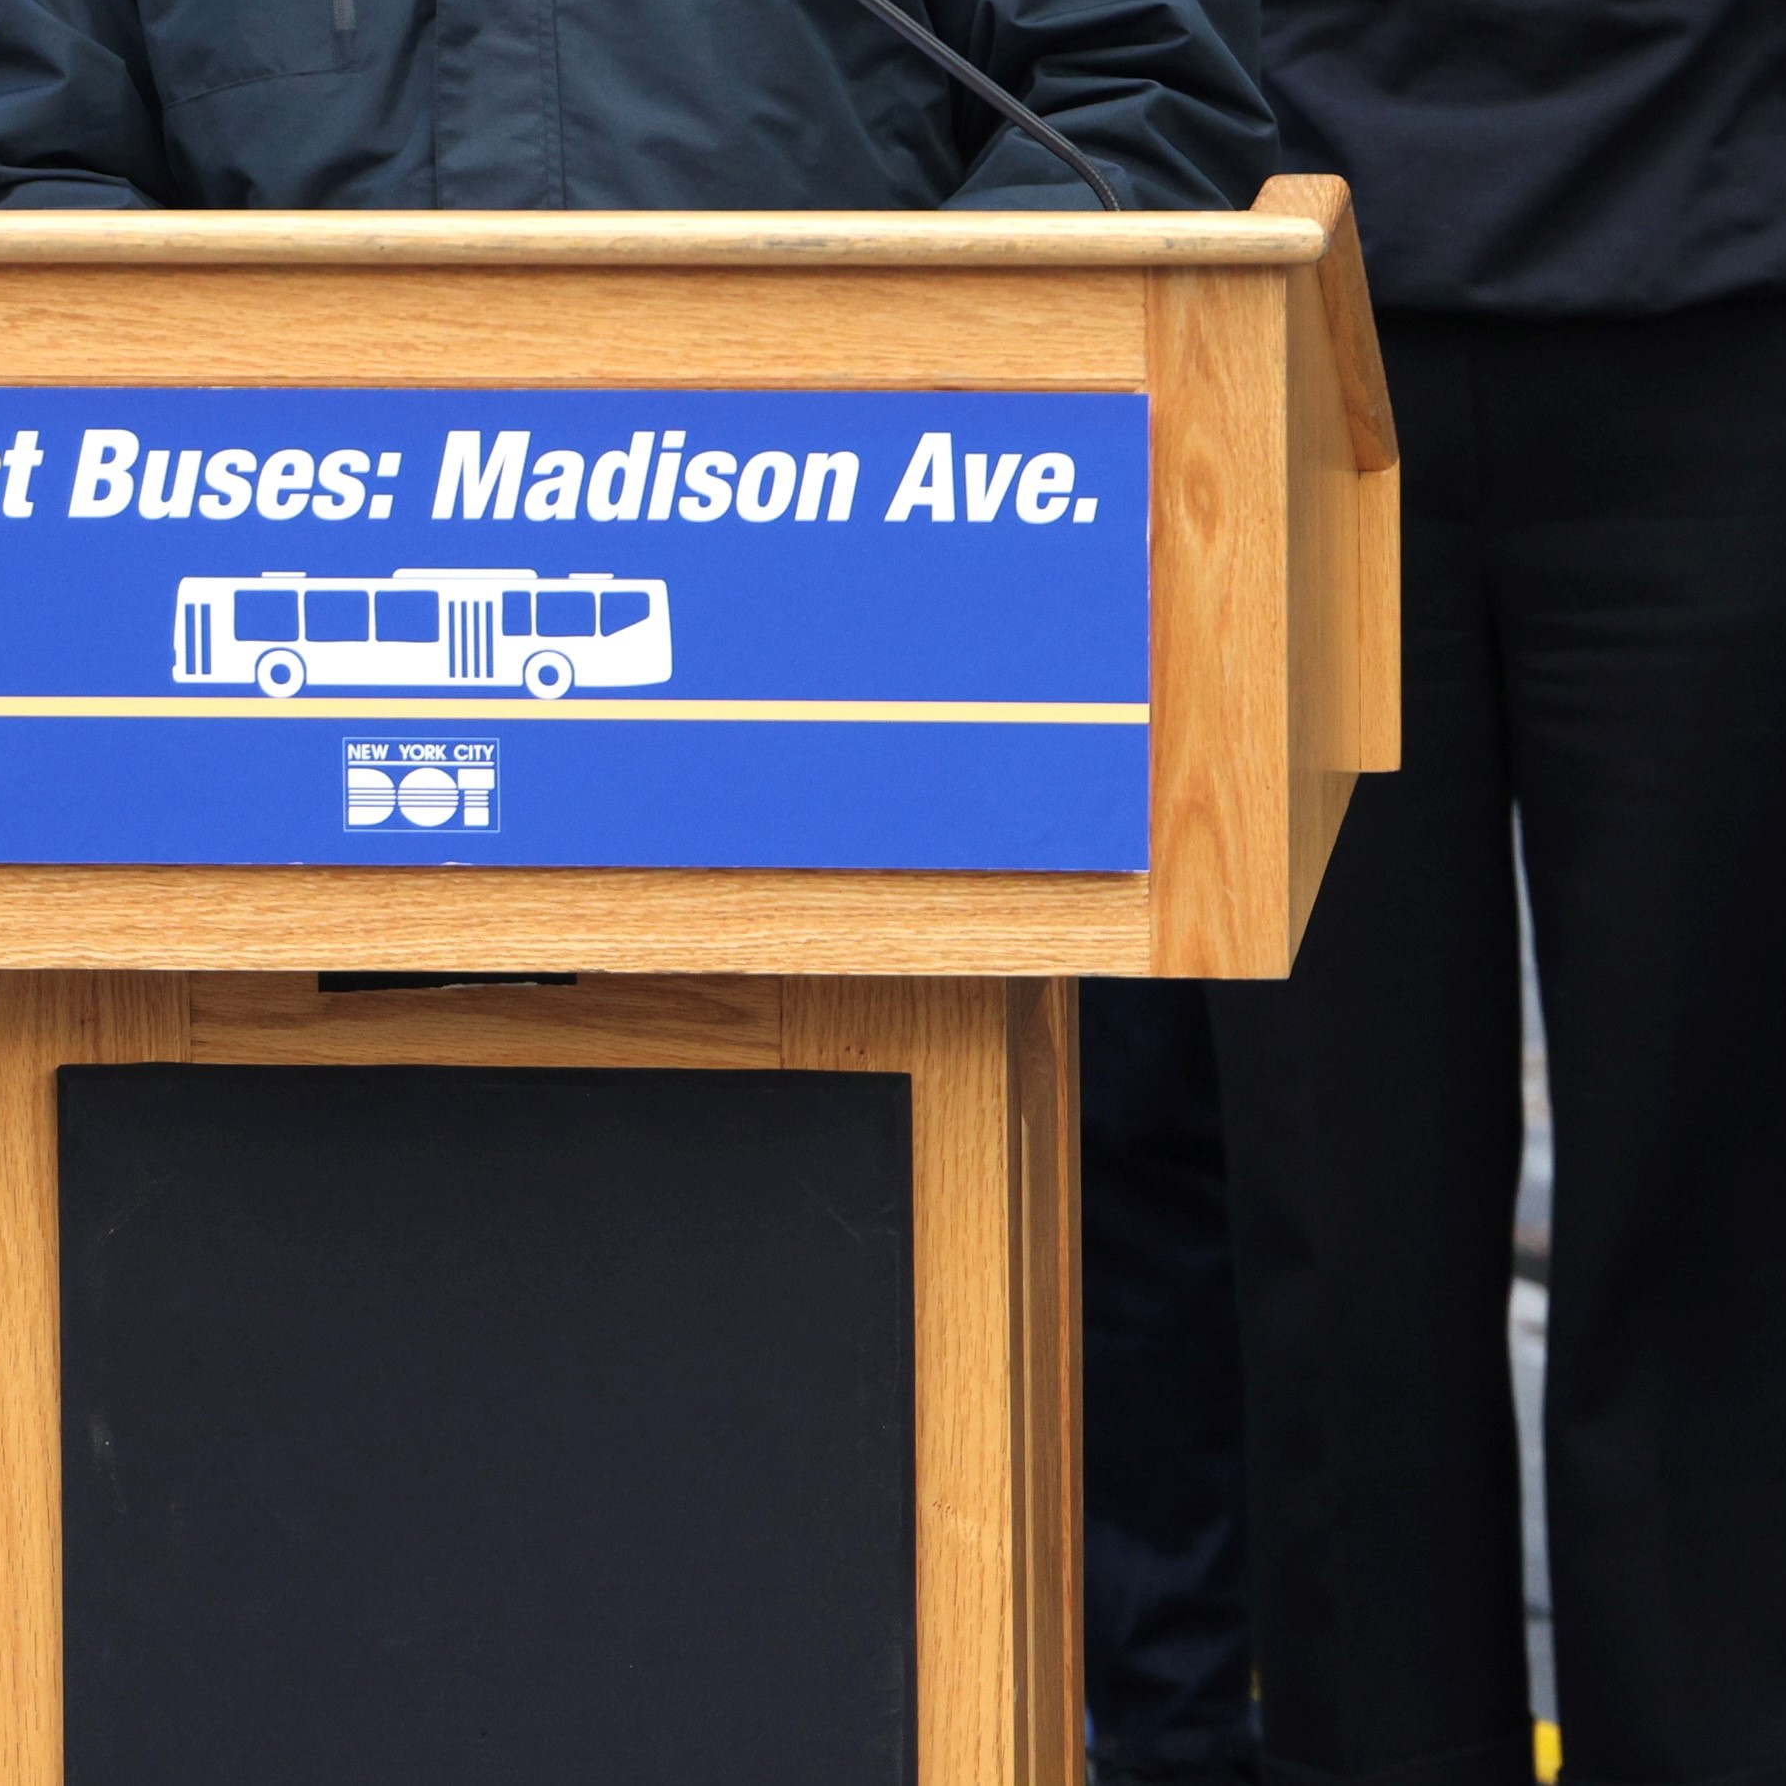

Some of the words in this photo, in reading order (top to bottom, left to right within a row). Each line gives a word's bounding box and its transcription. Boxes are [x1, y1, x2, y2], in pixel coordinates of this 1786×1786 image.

[69, 429, 403, 522] Buses:
[432, 431, 861, 524] Madison
[885, 432, 1100, 526] Ave.
[347, 743, 391, 761] NEW
[398, 743, 449, 761] YORK
[453, 744, 497, 761] CITY
[347, 767, 498, 829] DOT
